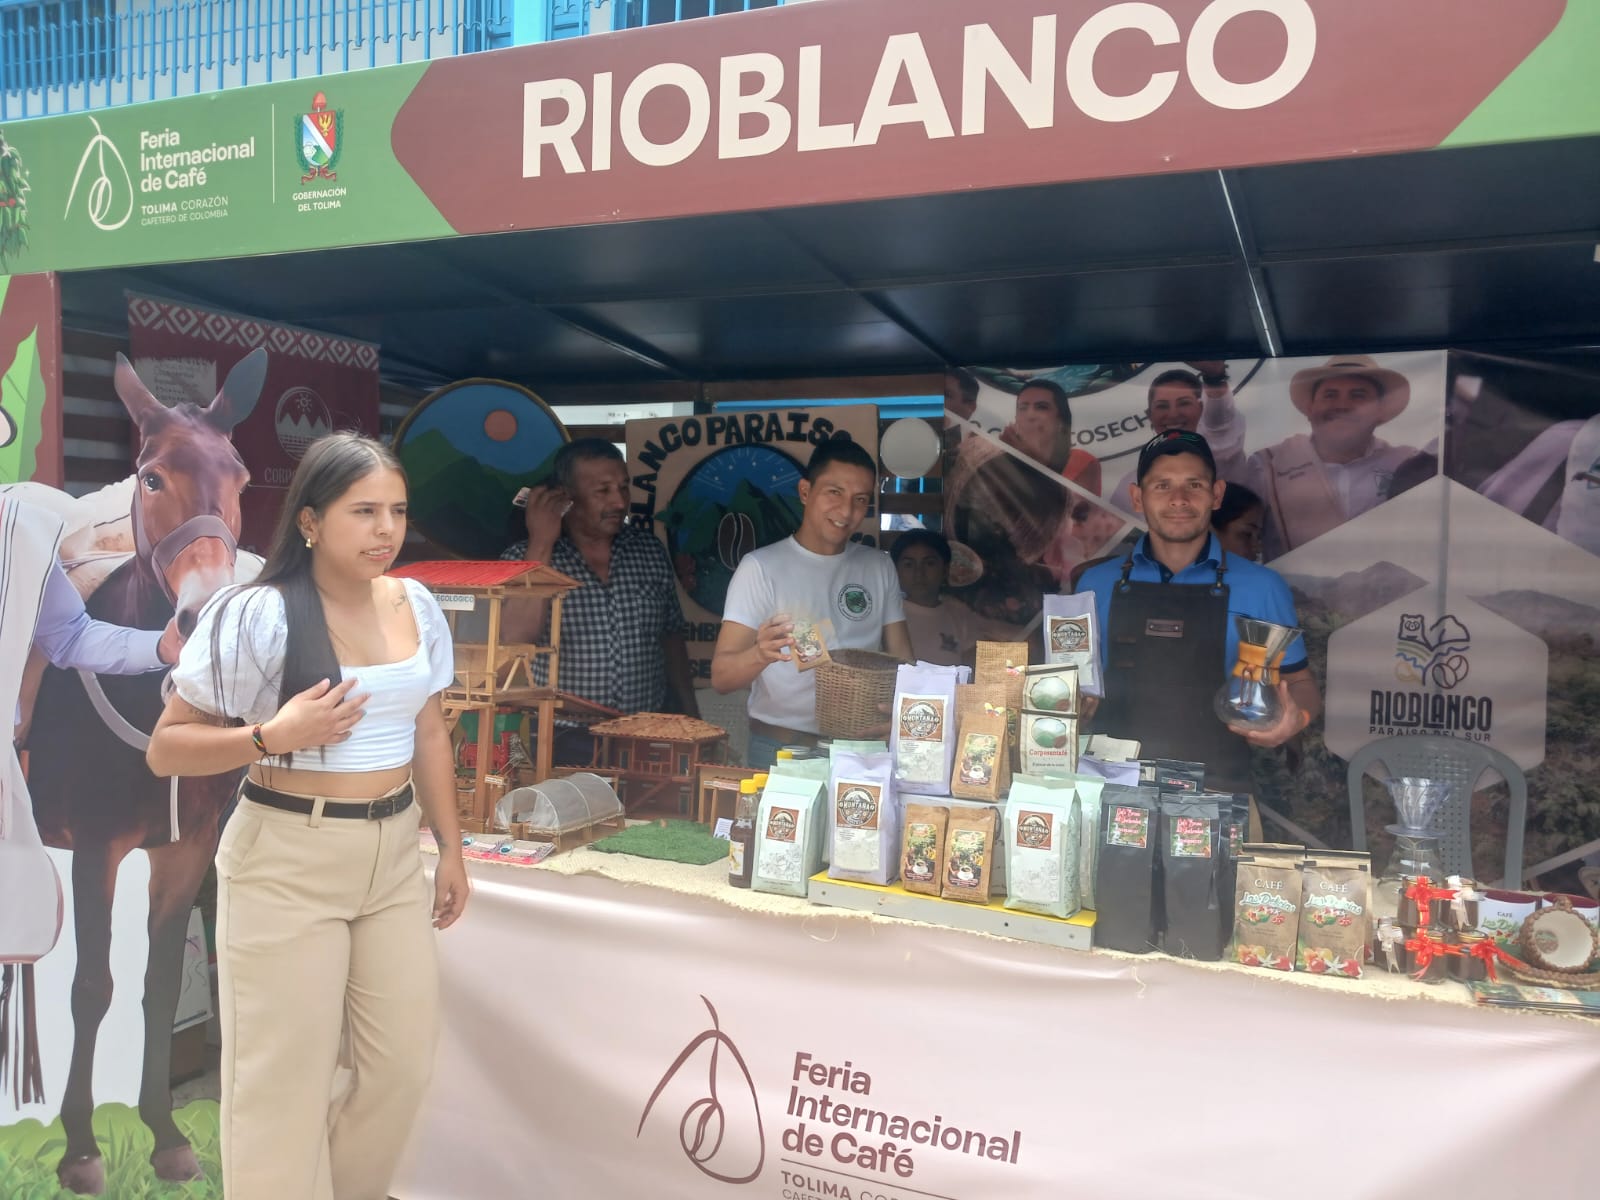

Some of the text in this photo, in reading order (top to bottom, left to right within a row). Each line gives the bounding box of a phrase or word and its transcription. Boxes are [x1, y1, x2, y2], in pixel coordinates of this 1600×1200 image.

[521, 0, 1317, 178] RIOBLANCO
[140, 128, 180, 151] Feria
[140, 136, 255, 172] Internacional
[140, 167, 207, 192] de Café
[141, 195, 229, 215] TOLIMA CORAZÓN
[141, 209, 229, 226] CAFETERO DE COLOMBIA
[298, 200, 341, 212] DEL TOLIMA
[1370, 690, 1492, 732] RIOBLANCO
[1465, 731, 1491, 742] SUR
[792, 1052, 872, 1096] Feria
[786, 1086, 1022, 1165] Internacional
[782, 1123, 915, 1178] de Café
[781, 1170, 852, 1200] TOLIMA
